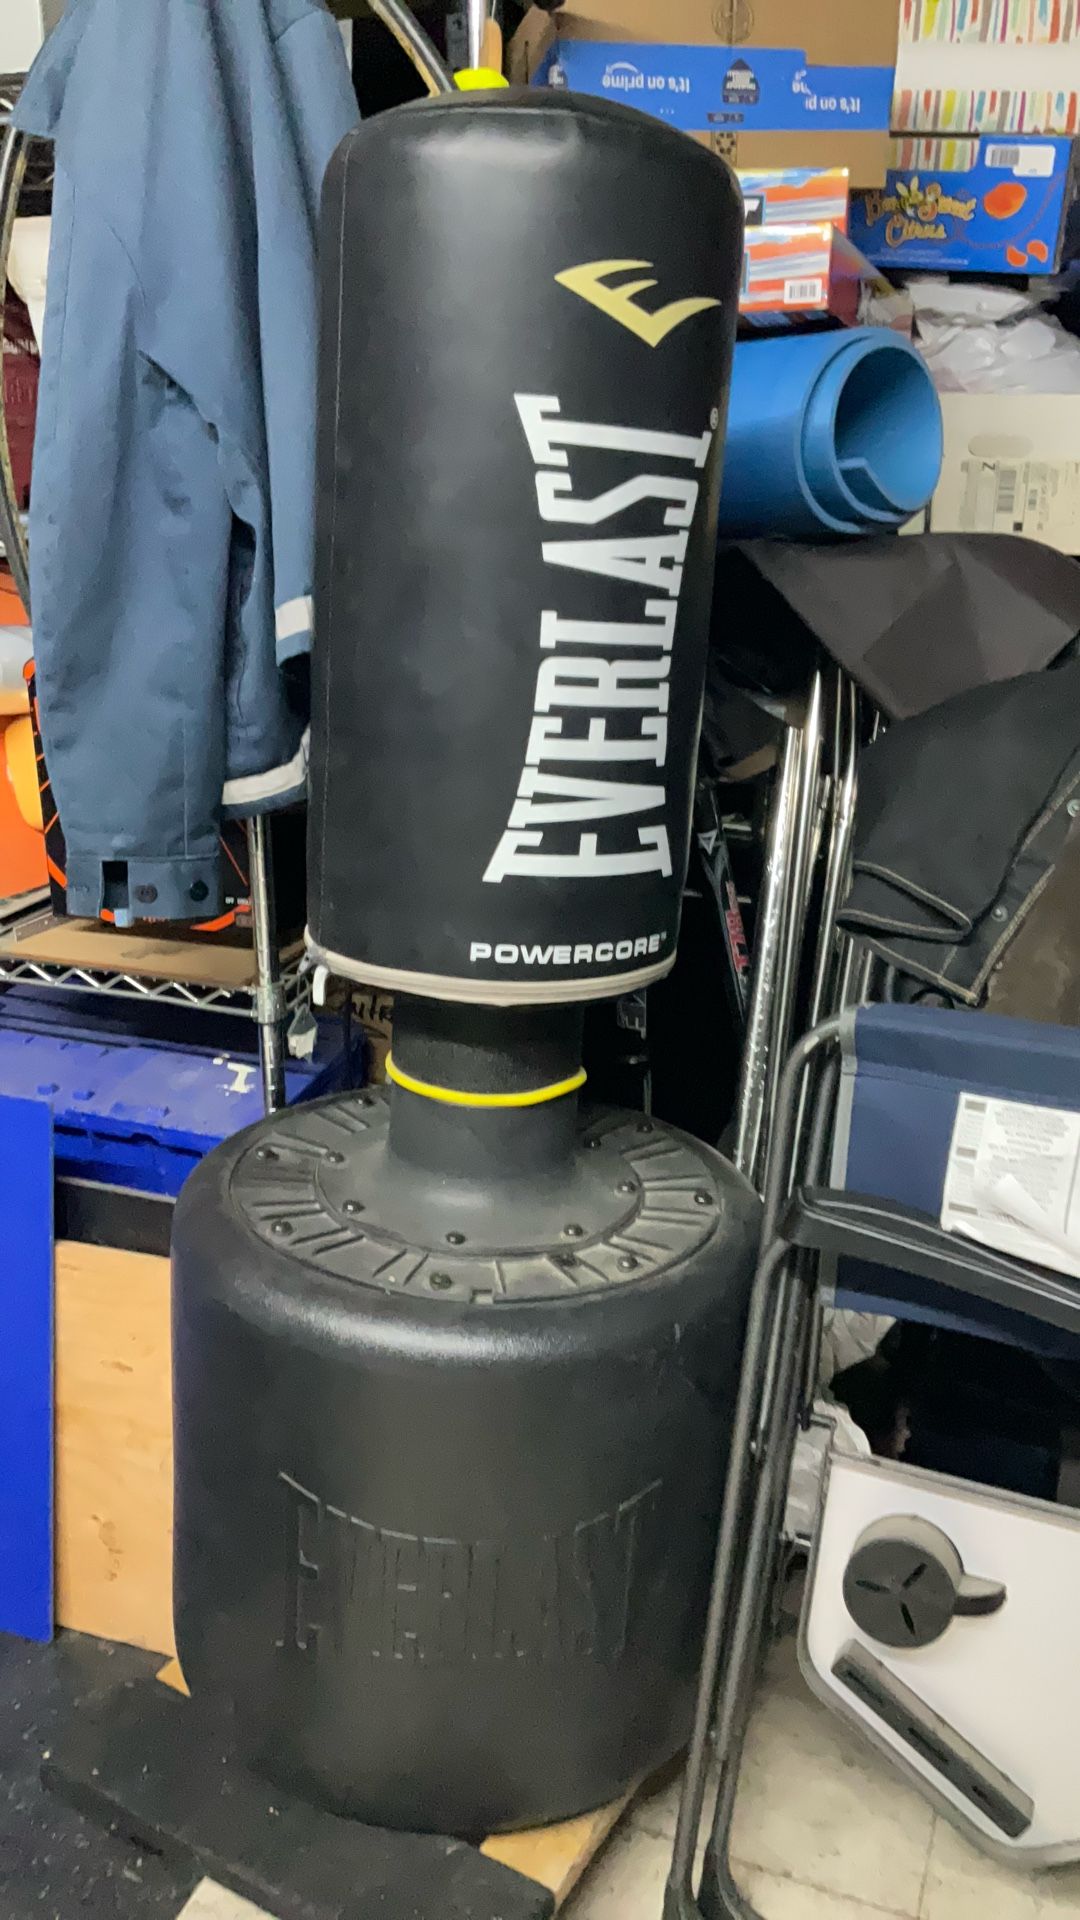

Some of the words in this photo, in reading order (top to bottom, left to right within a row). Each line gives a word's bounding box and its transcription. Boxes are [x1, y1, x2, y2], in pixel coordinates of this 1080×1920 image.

[602, 72, 645, 92] prime
[648, 76, 665, 91] on
[669, 75, 691, 93] It's
[819, 97, 837, 112] on
[839, 96, 860, 114] It's
[482, 393, 712, 883] EVERLAST
[469, 934, 661, 965] POWERCORE
